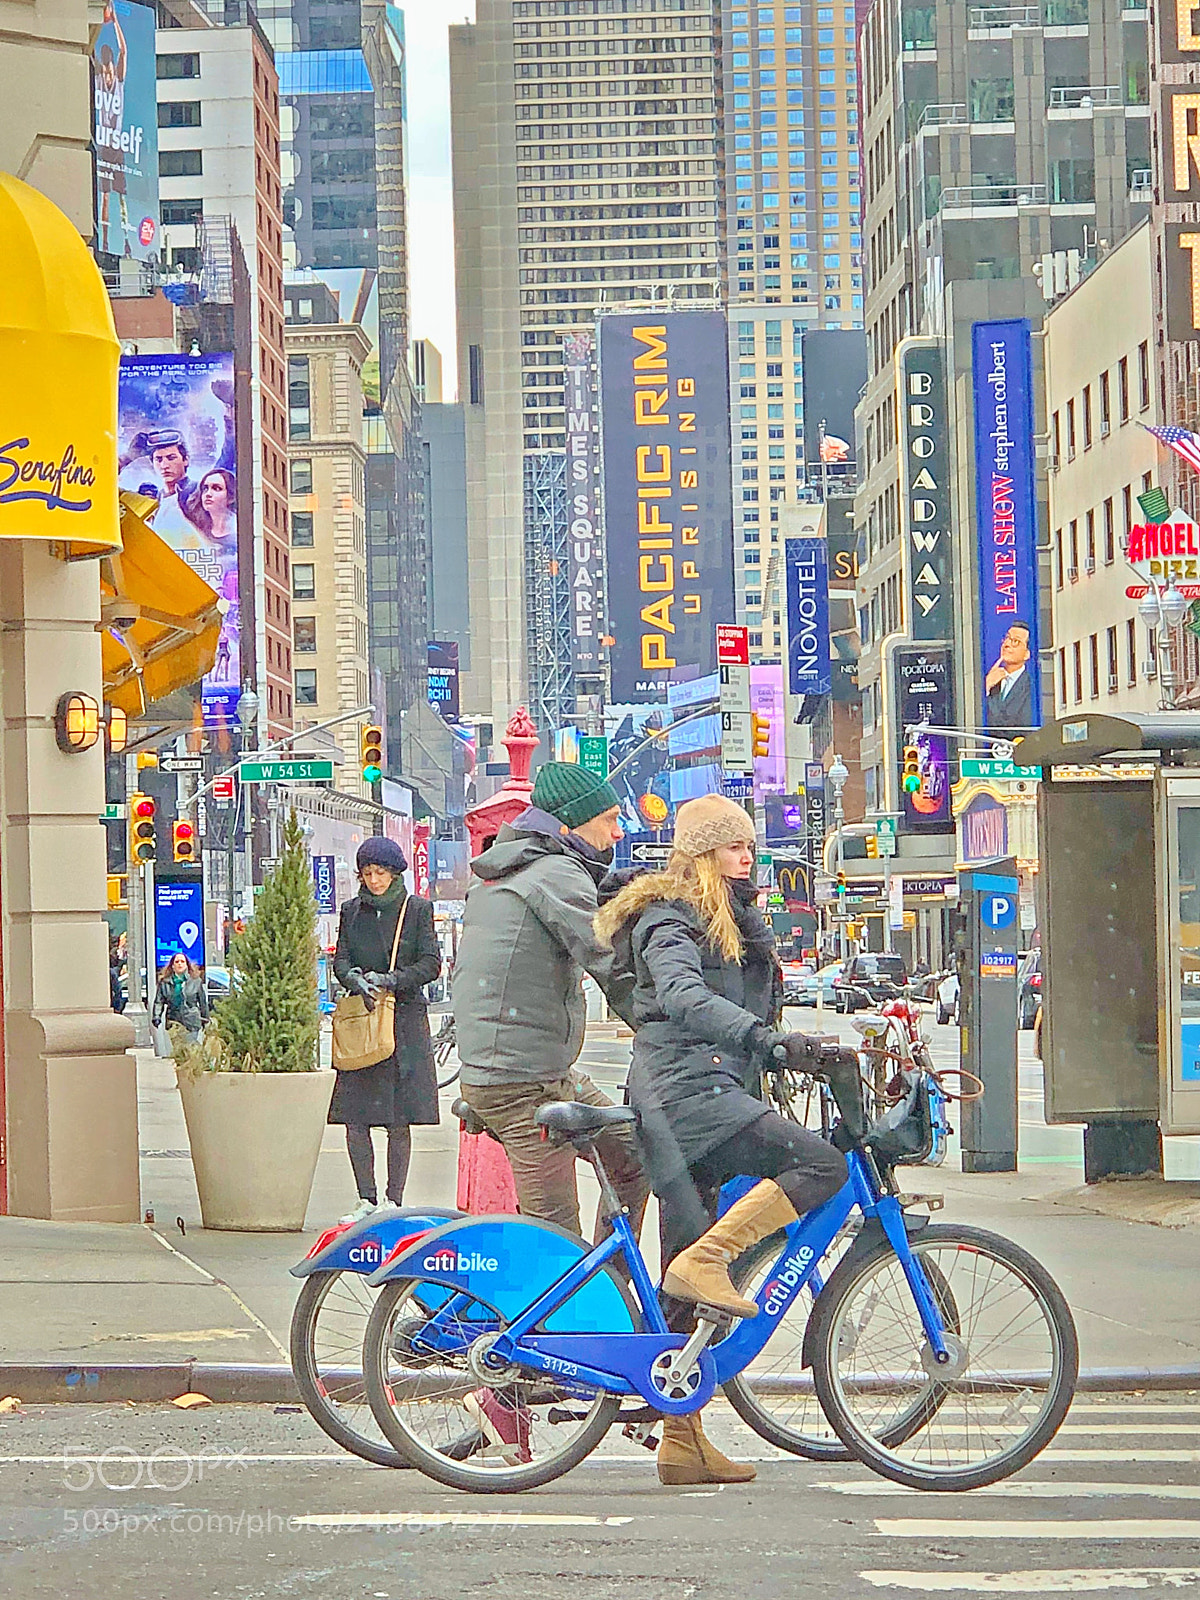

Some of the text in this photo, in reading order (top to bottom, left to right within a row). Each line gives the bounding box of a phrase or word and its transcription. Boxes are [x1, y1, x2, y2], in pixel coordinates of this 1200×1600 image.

[632, 325, 670, 425] RIM
[988, 341, 1014, 471] stephen colbert
[0, 437, 95, 499] Serafina
[566, 365, 594, 637] TIMES SQUARE
[677, 378, 701, 614] UPRISING
[910, 372, 940, 617] BROADWAY
[637, 445, 676, 669] PACIFIC
[992, 472, 1017, 615] LATE SHOW
[795, 550, 819, 674] NOVOTEL
[902, 664, 945, 677] ROCKTOPIA
[723, 713, 729, 730] 6
[261, 765, 313, 777] W 54 St
[978, 763, 1037, 775] W 54 St
[992, 897, 1009, 925] P
[984, 956, 1013, 965] 102917
[542, 1357, 578, 1377] 31123
